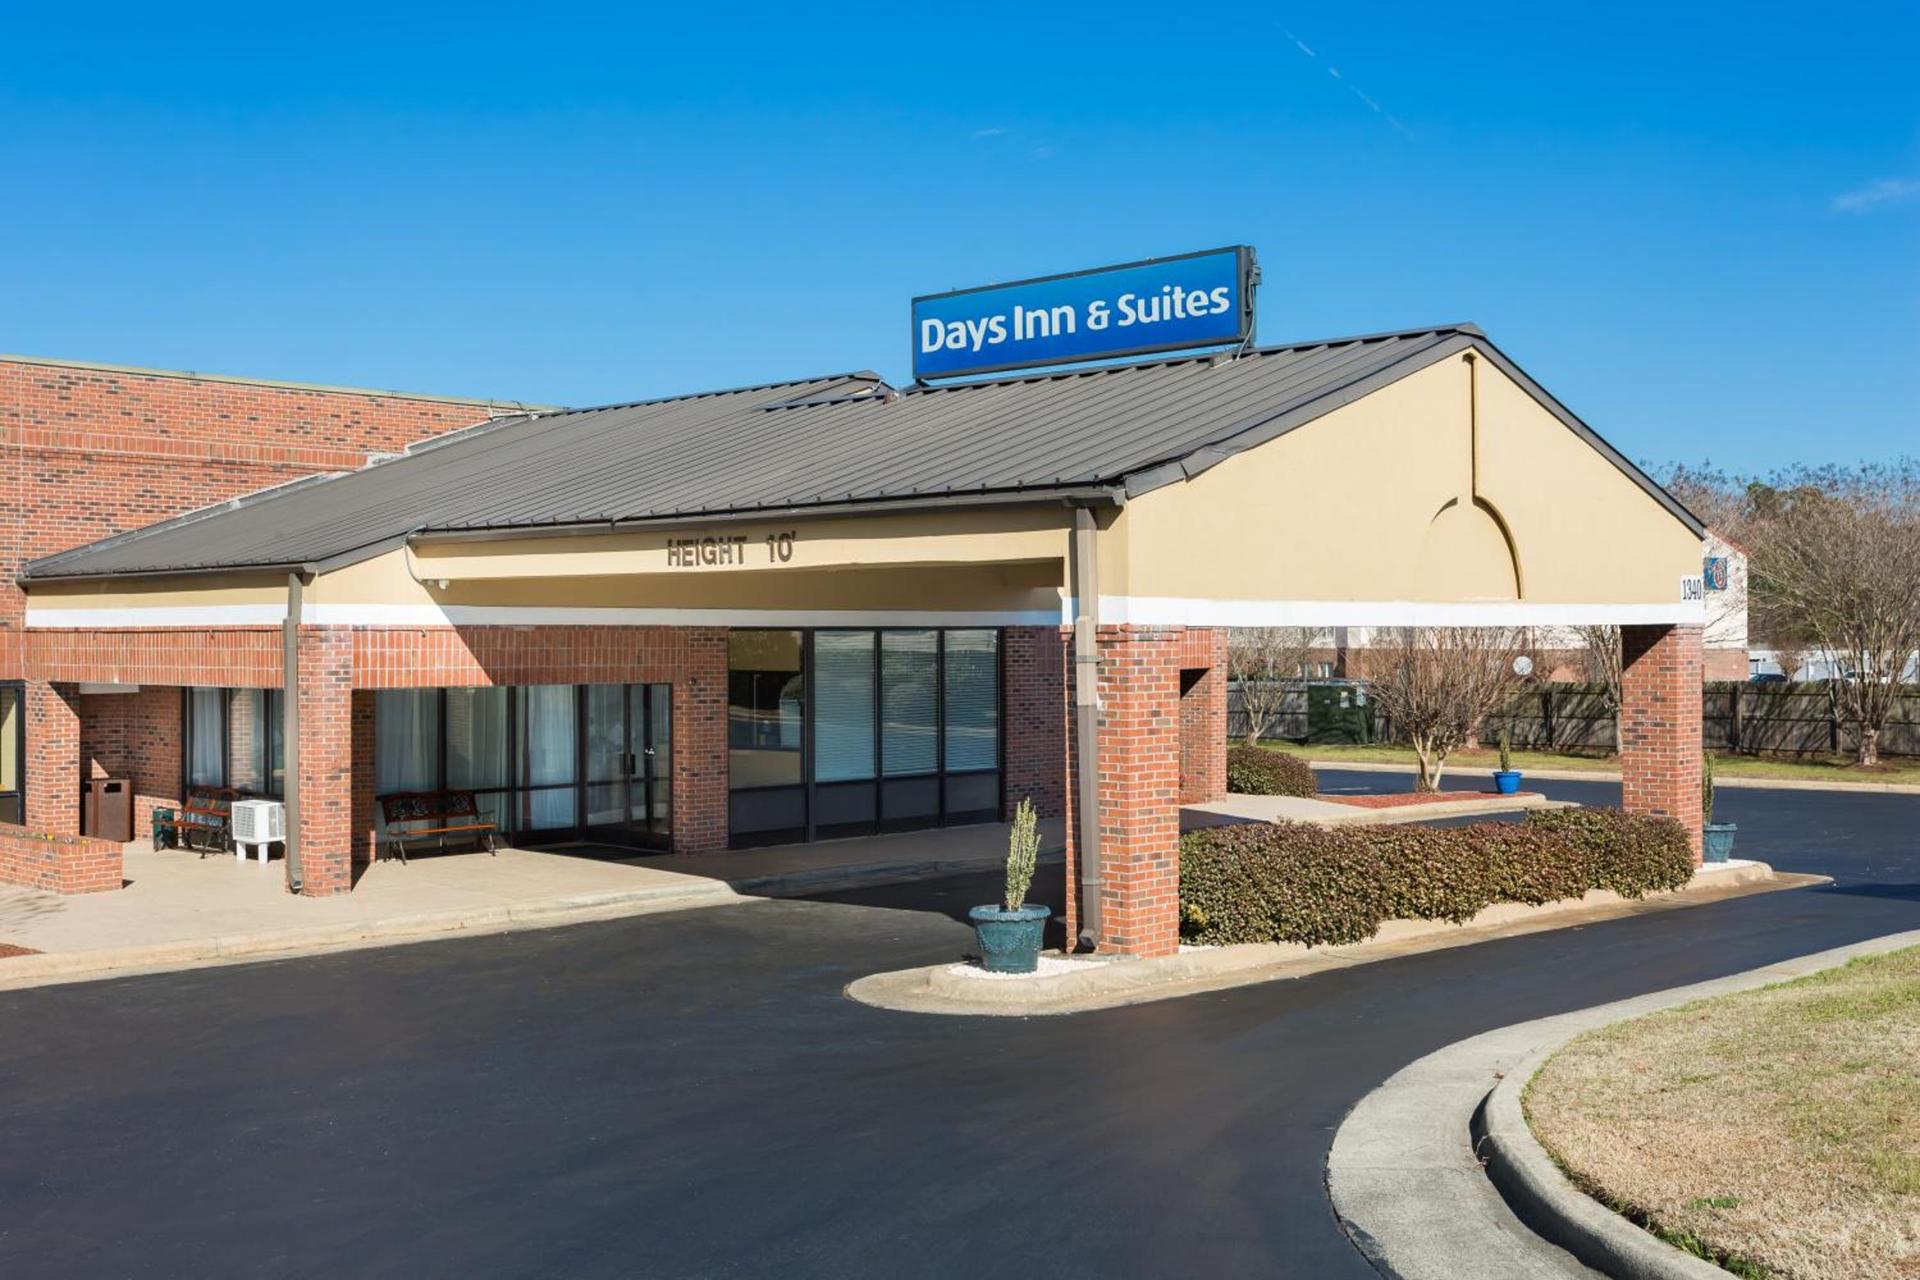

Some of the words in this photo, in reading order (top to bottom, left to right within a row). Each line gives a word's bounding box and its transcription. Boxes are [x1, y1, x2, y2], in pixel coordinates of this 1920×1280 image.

[921, 315, 1007, 353] Days
[1014, 305, 1076, 341] Inn
[1087, 300, 1111, 331] &
[1117, 285, 1231, 328] Suites
[667, 536, 747, 566] HEIGHT
[766, 530, 797, 563] 10'
[1682, 578, 1702, 600] 1340
